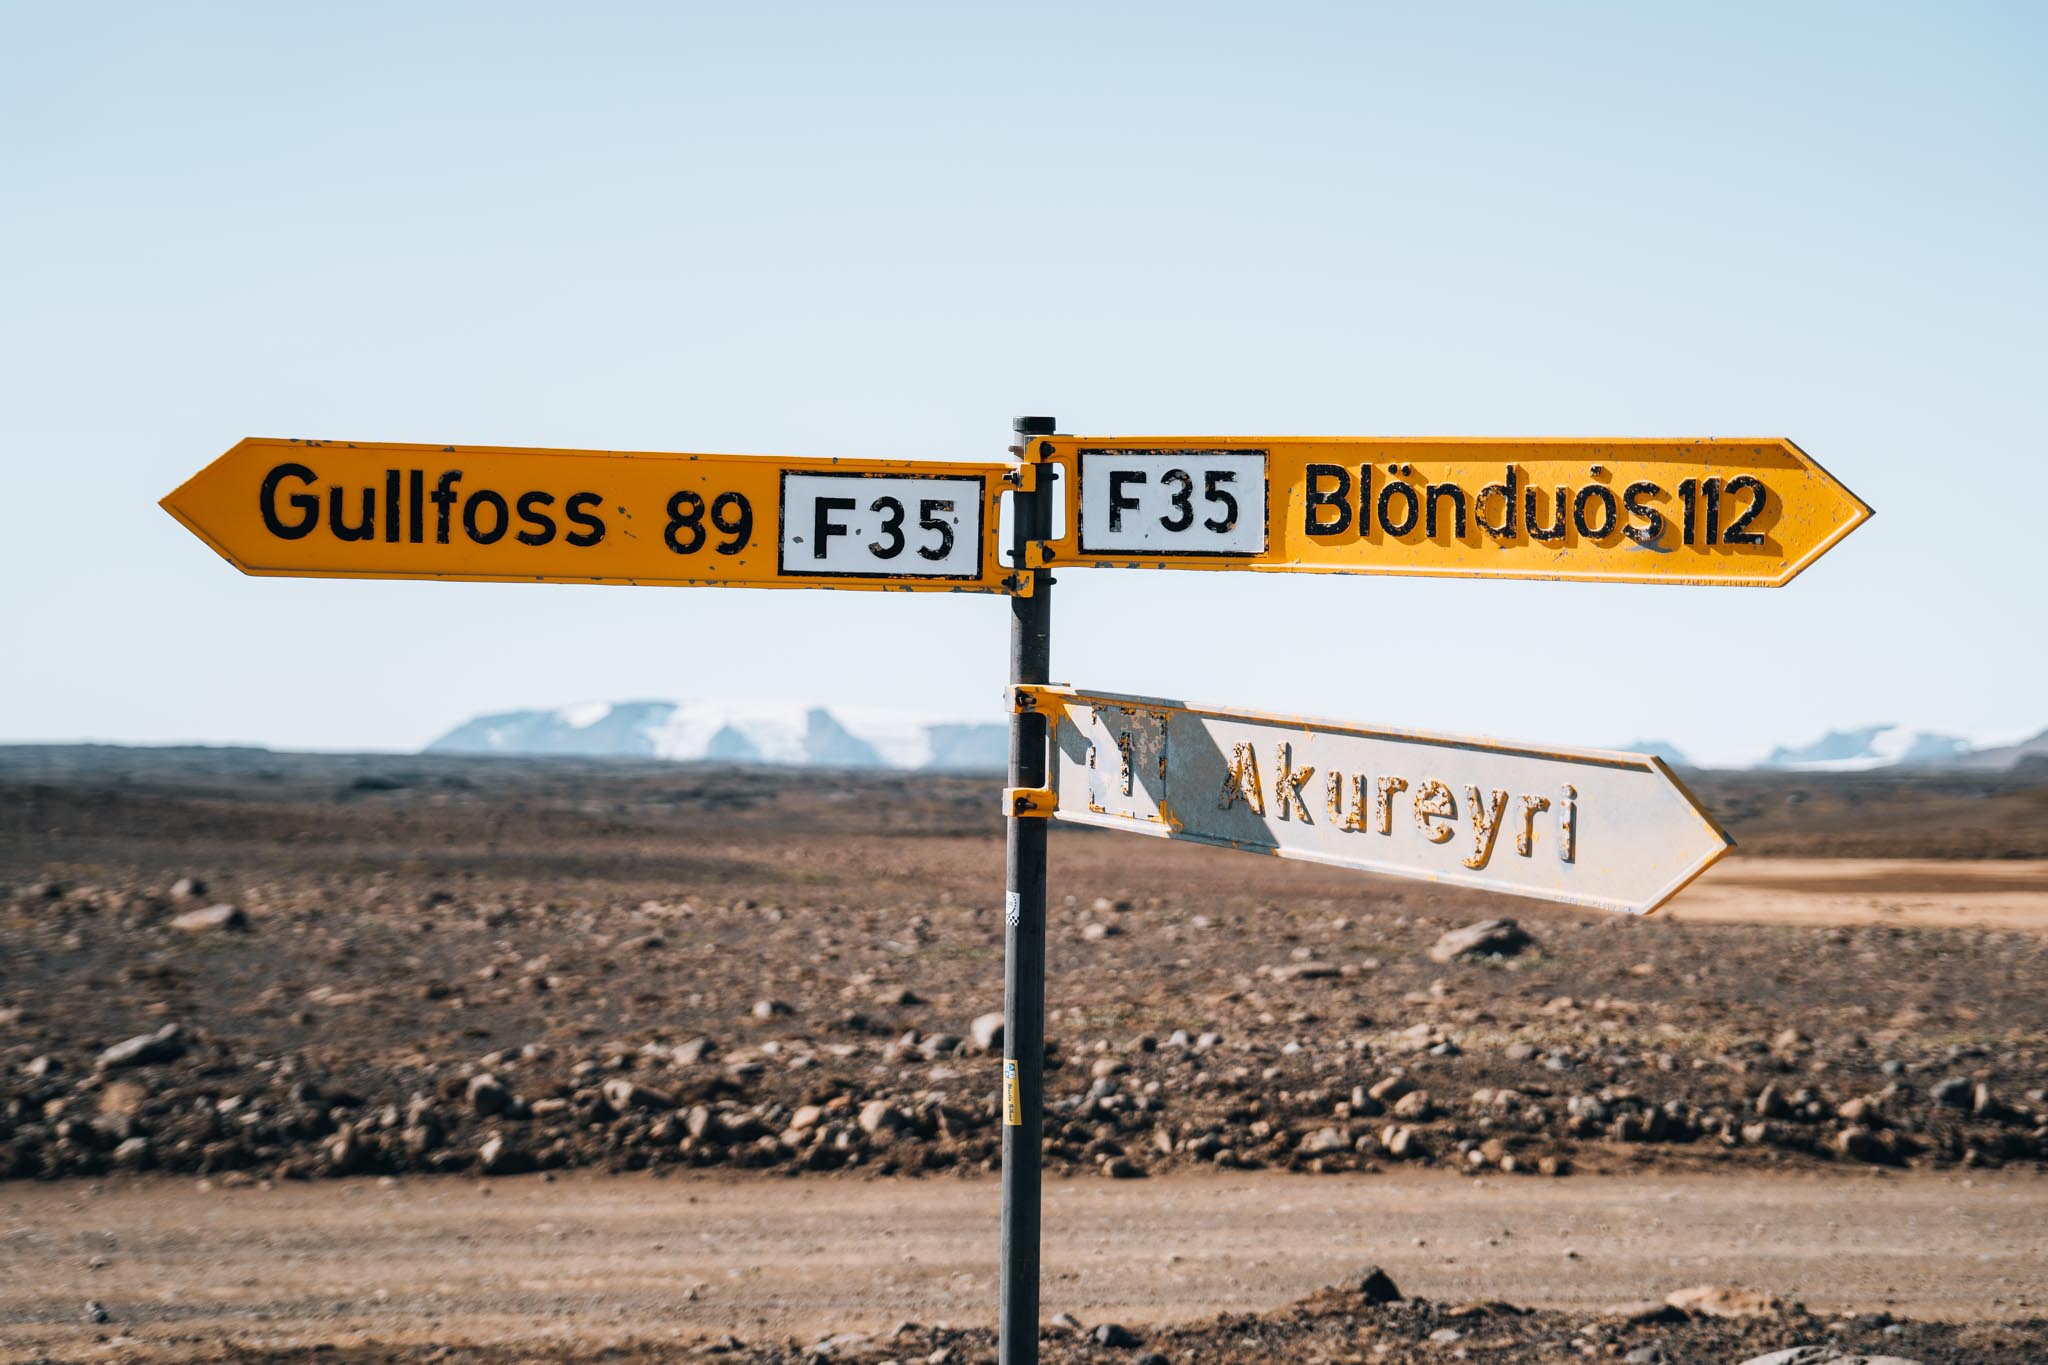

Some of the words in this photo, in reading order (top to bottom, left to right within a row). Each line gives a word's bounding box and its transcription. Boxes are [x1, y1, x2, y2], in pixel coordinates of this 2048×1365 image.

[259, 462, 606, 547] Gullfoss
[664, 490, 753, 555] 89
[814, 496, 954, 560] F35
[1108, 469, 1238, 533] F35
[1679, 475, 1767, 545] 112
[1219, 741, 1578, 870] Akureyri
